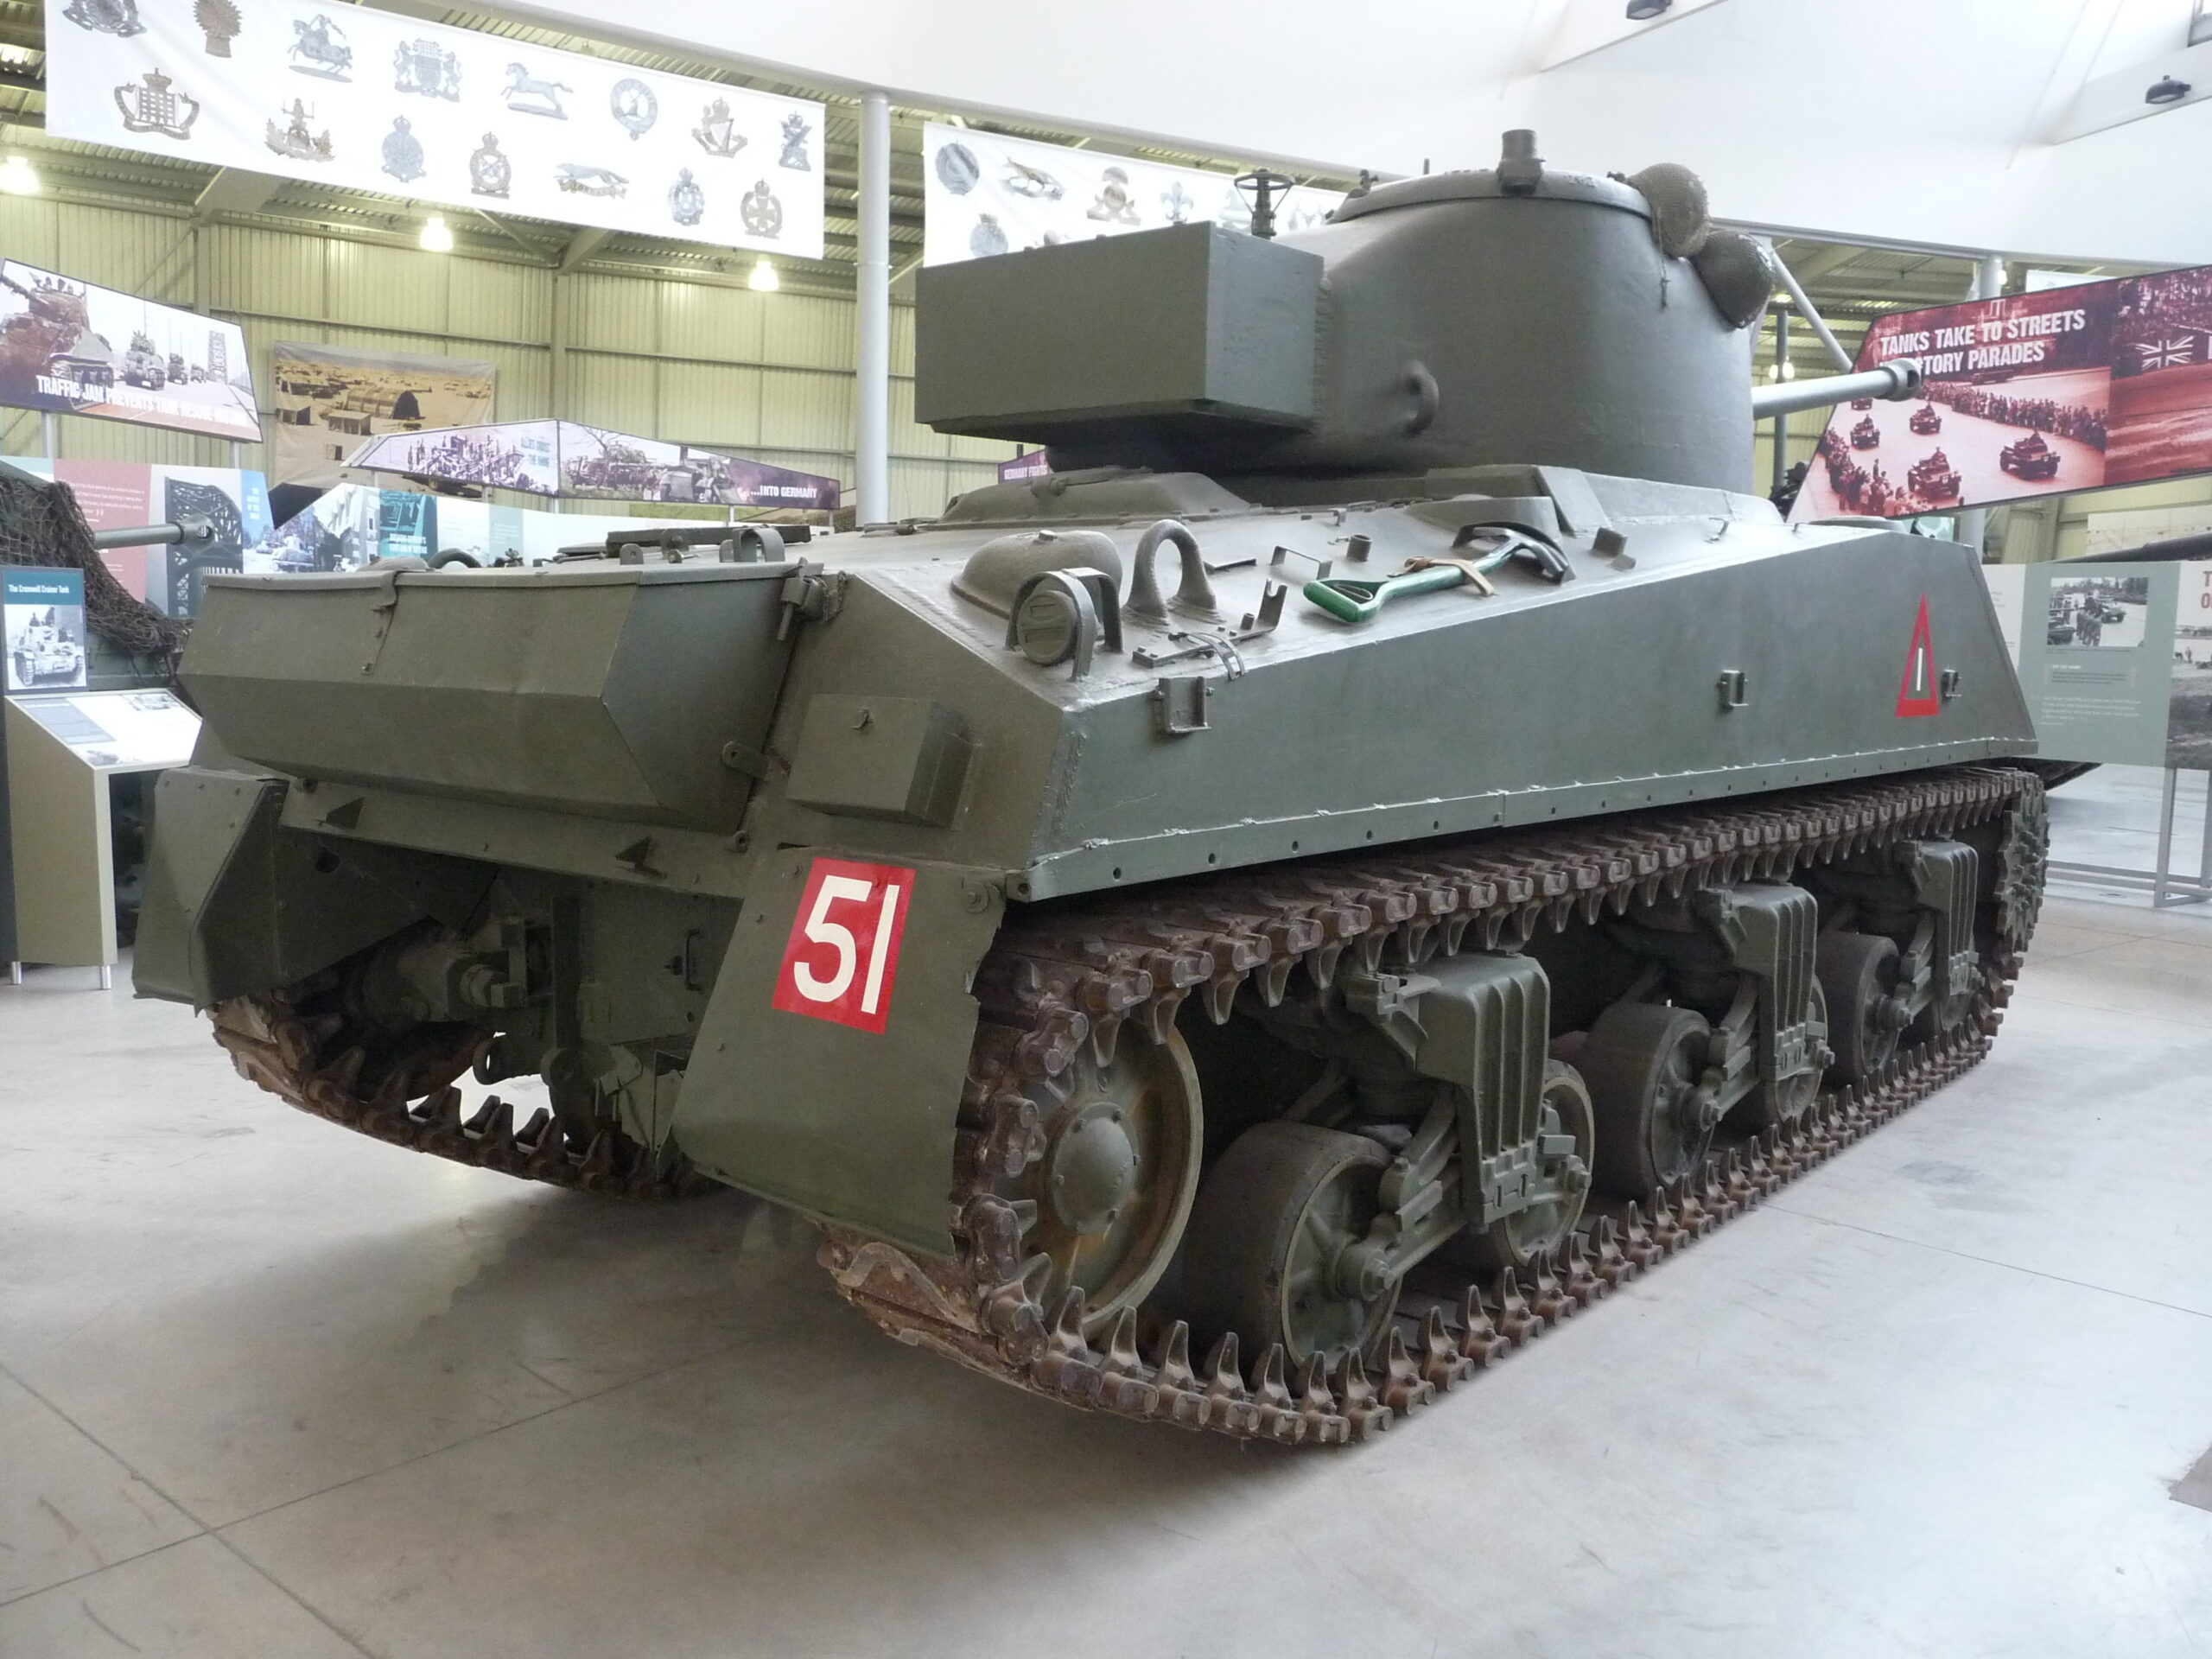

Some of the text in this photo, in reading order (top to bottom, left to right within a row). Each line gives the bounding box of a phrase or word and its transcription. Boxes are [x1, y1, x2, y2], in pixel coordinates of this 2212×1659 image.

[1880, 308, 2086, 356] TANKS TAKE TO STREETS
[1968, 340, 2044, 370] PARADES
[35, 375, 81, 399] TRAFFIC
[82, 383, 105, 403] JAM
[780, 486, 817, 499] GERMANY
[794, 874, 900, 1014] 51
